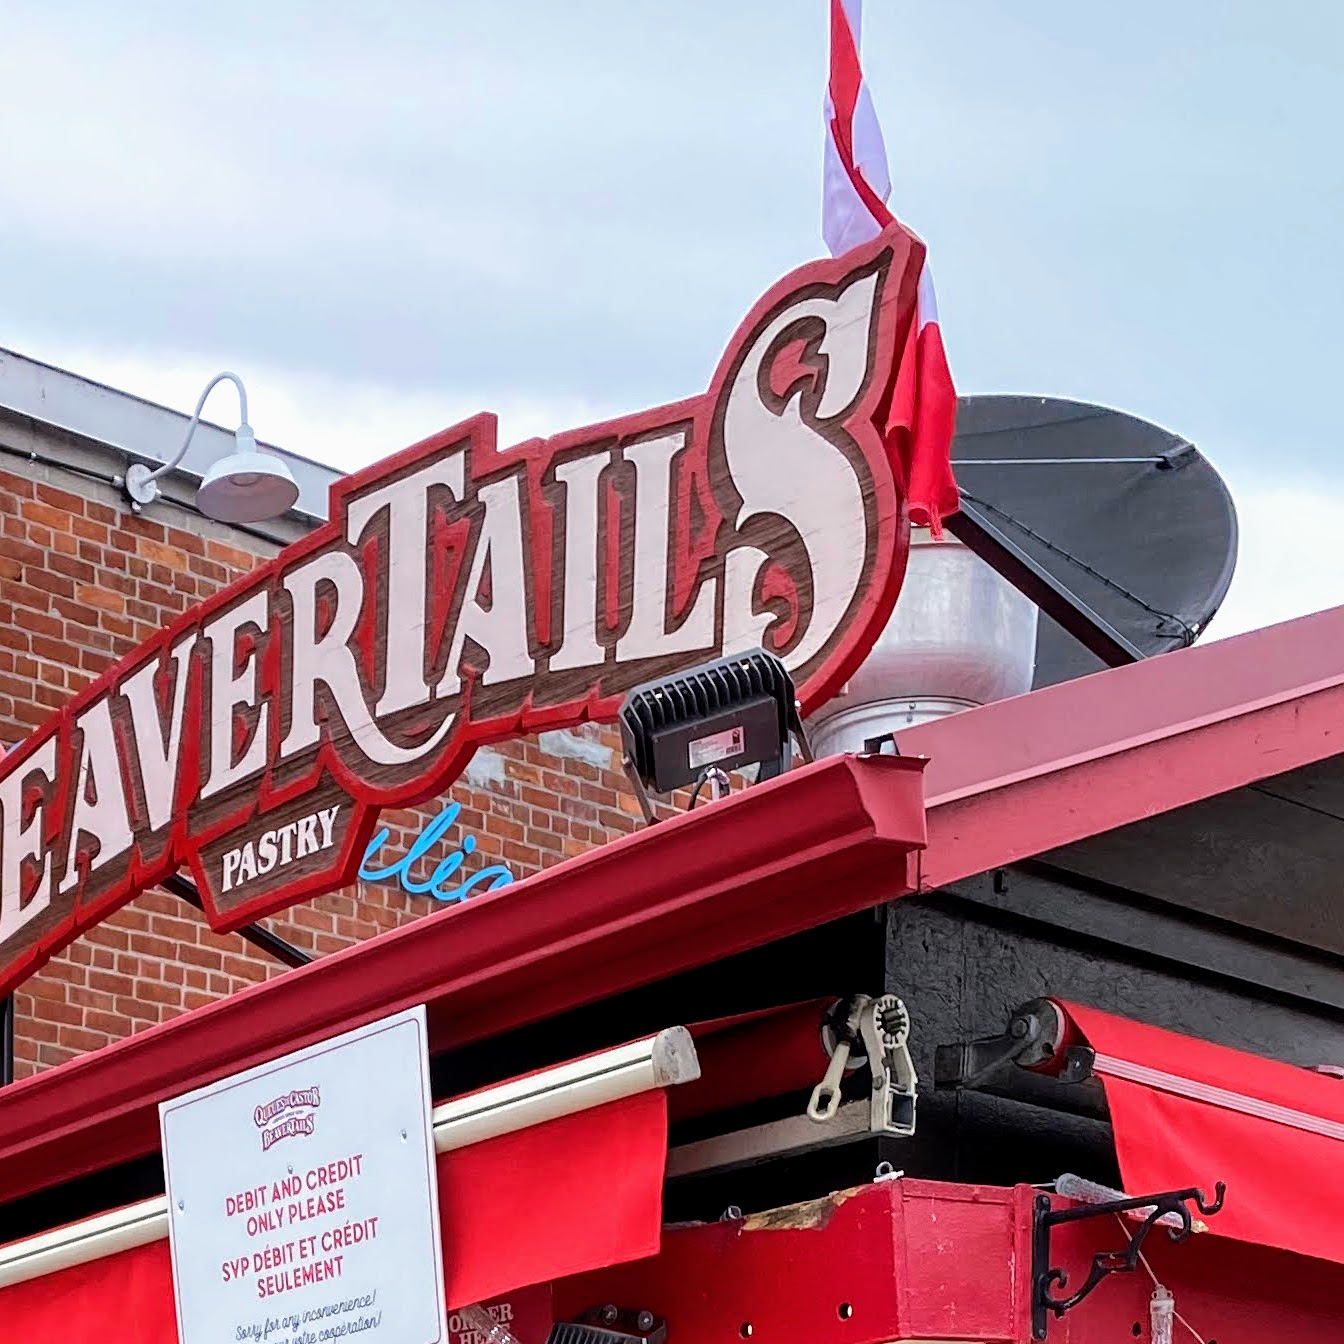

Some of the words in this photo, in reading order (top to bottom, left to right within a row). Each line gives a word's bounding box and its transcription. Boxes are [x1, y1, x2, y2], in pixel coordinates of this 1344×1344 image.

[221, 805, 340, 893] PASTRY
[225, 1182, 267, 1217] DEBIT
[271, 1175, 303, 1204] AND
[305, 1154, 363, 1193] CREDIT
[246, 1207, 283, 1237] ONLY
[288, 1188, 346, 1225] PLEASE
[221, 1254, 250, 1282] SVP
[253, 1243, 295, 1274] DÉBIT
[299, 1235, 318, 1258] ET
[320, 1217, 379, 1253] CRÉDIT
[257, 1256, 344, 1298] SEULEMENT
[235, 1319, 264, 1343] Sorry
[263, 1315, 281, 1338] for
[281, 1312, 301, 1333] any
